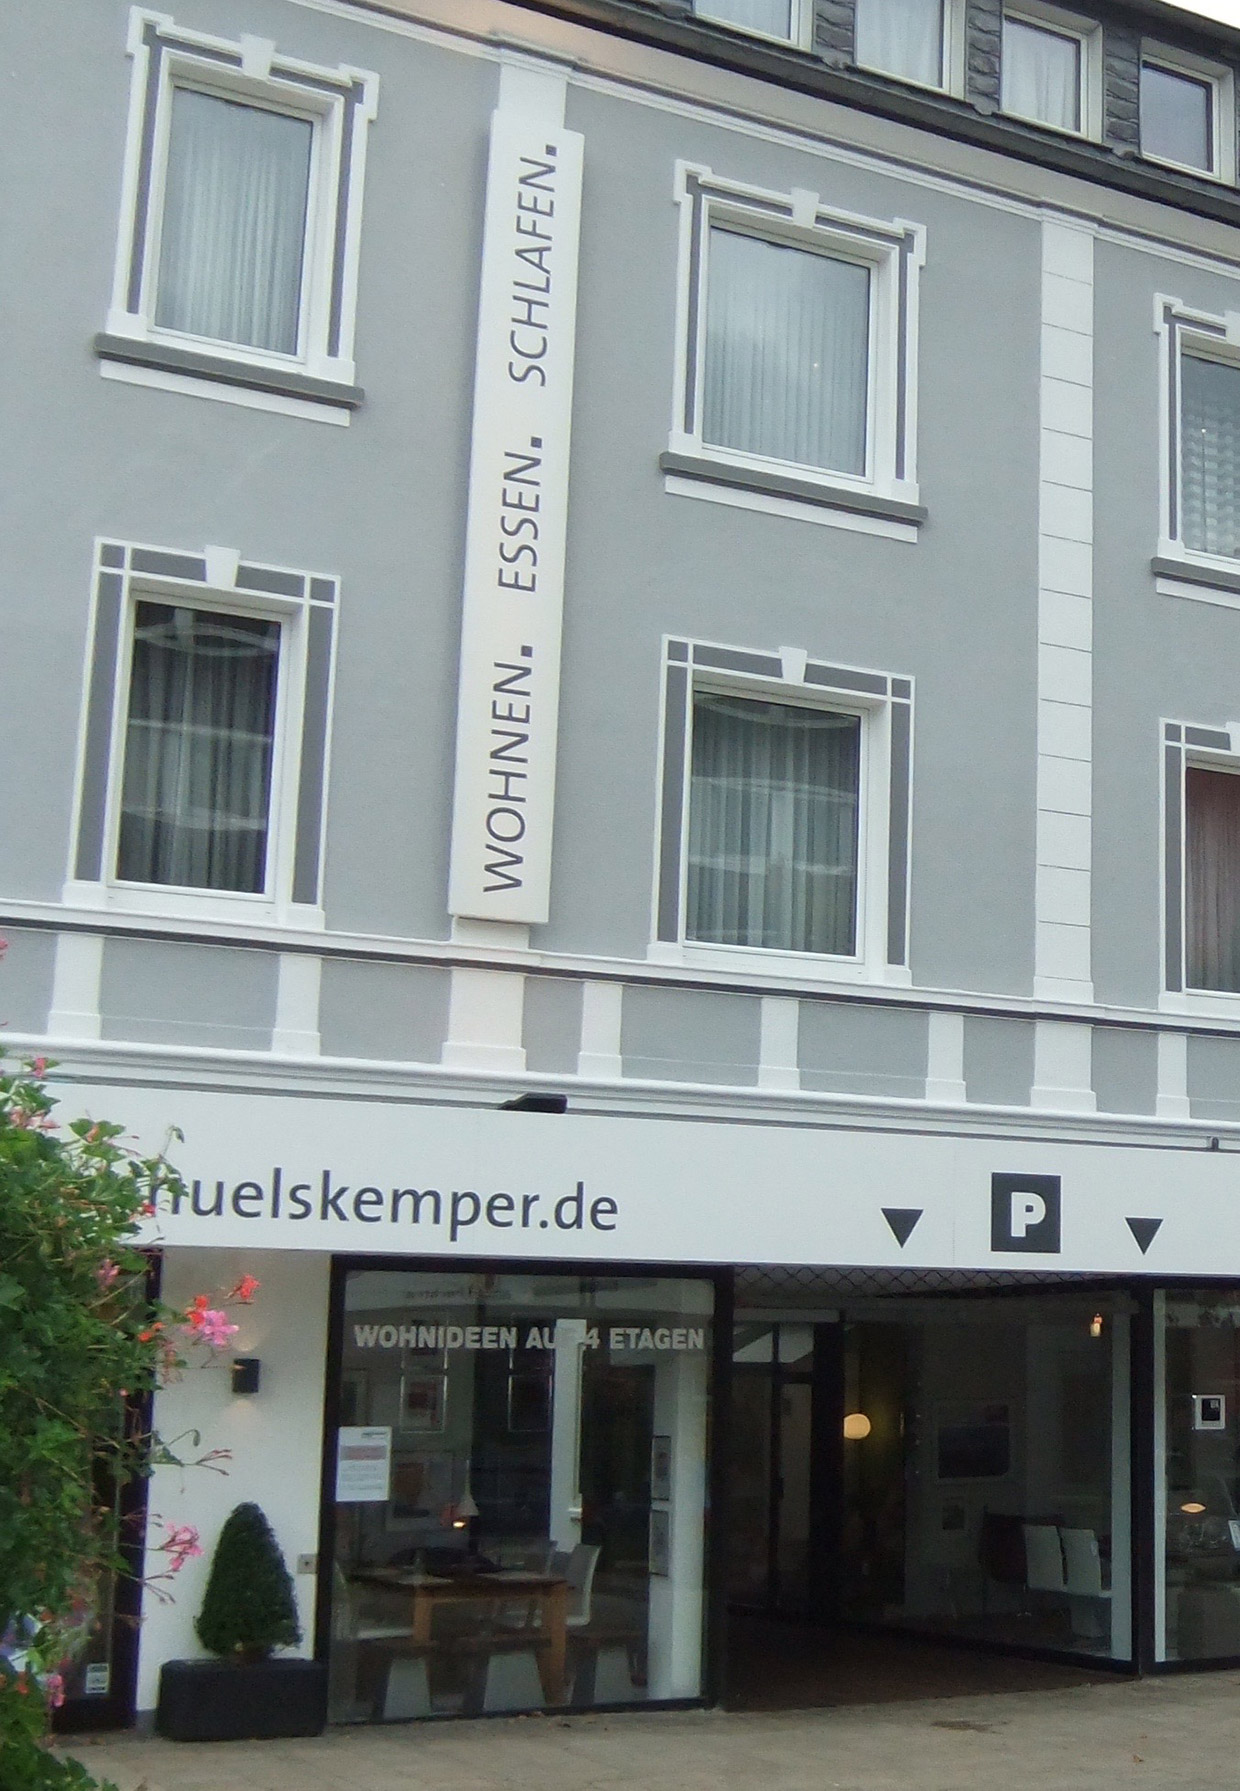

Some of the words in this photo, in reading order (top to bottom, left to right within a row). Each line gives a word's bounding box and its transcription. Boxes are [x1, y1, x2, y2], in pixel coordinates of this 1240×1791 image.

[509, 144, 557, 387] SCHLAFEN.
[497, 436, 542, 592] ESSEN.
[484, 645, 533, 893] WOHNEN.
[1010, 1191, 1046, 1237] P
[354, 1325, 518, 1350] WOHNIDEEN
[583, 1326, 601, 1350] 4
[609, 1327, 705, 1351] ETAGEN
